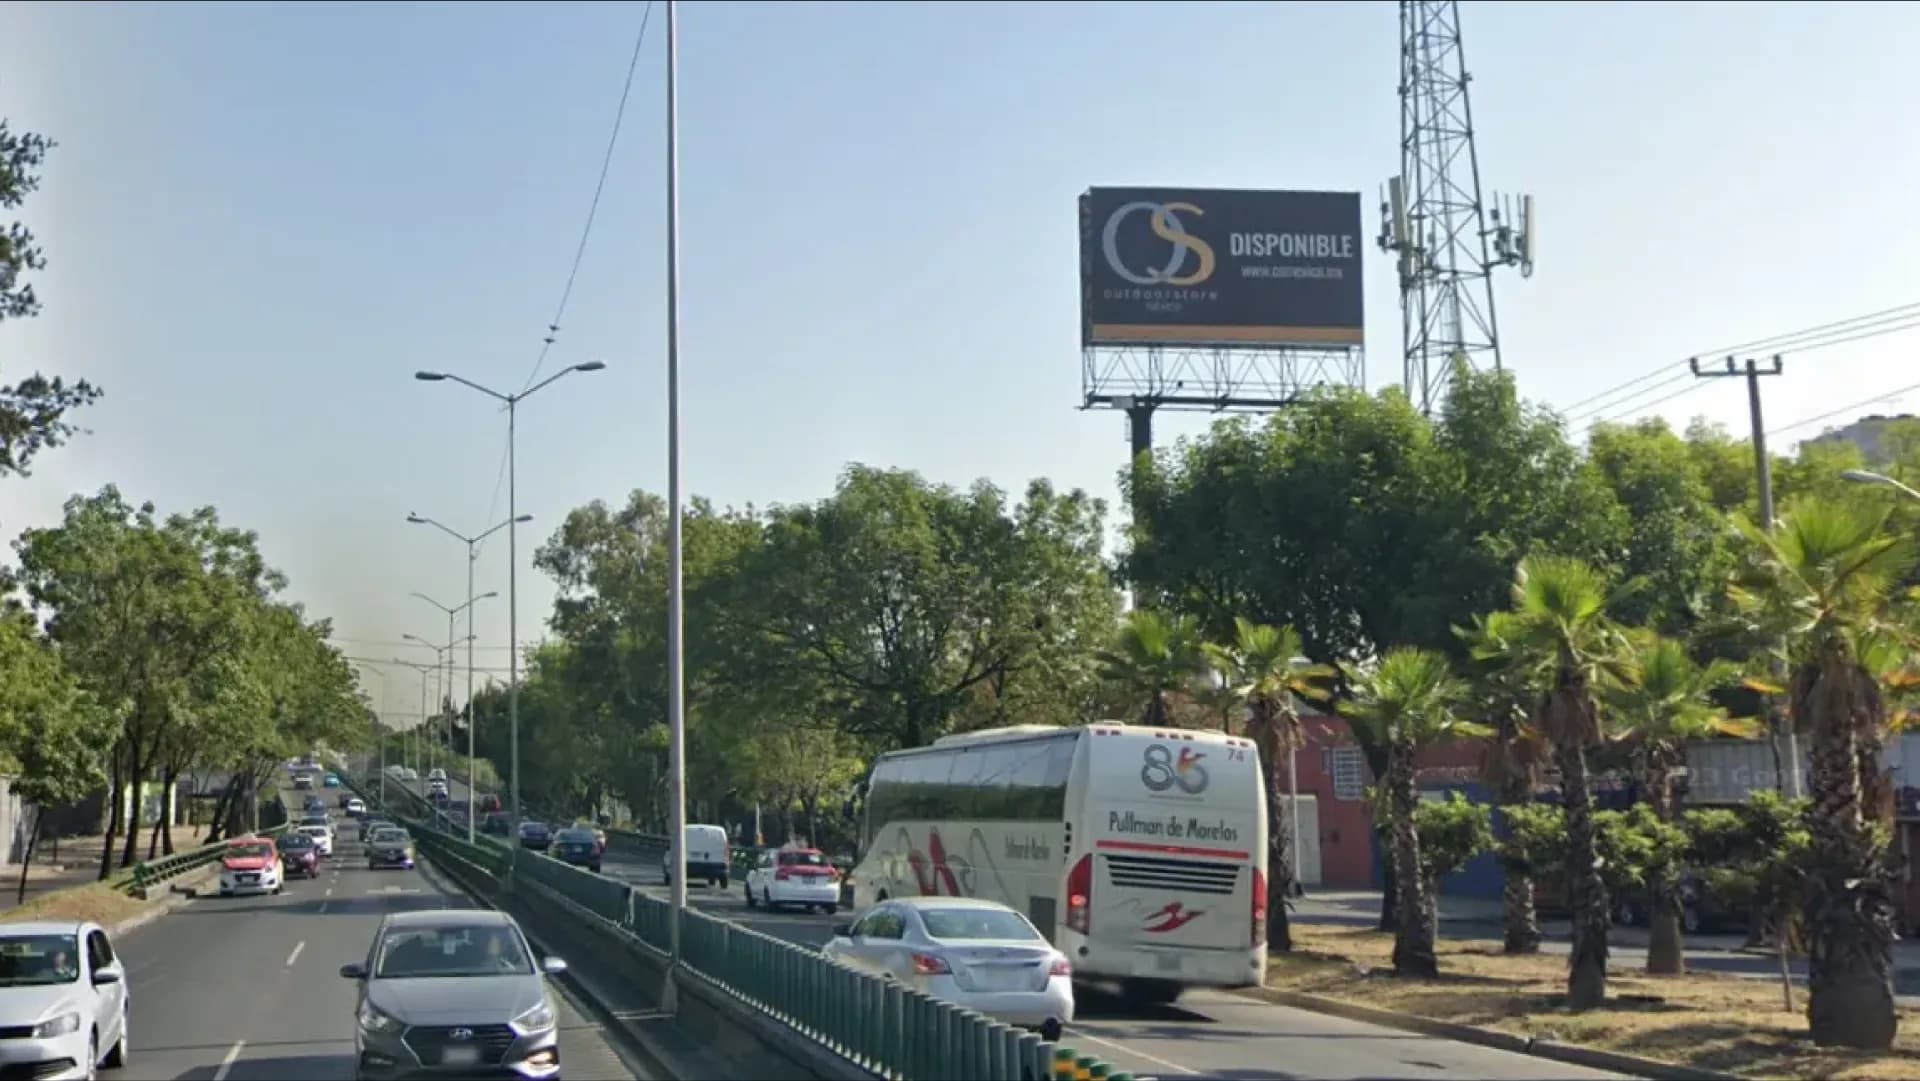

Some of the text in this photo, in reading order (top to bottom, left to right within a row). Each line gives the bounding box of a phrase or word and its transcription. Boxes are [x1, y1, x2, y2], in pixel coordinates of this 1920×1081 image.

[1229, 232, 1353, 258] DISPONIBLE
[1228, 748, 1246, 763] 74
[1109, 810, 1238, 842] Pullman de Morelos
